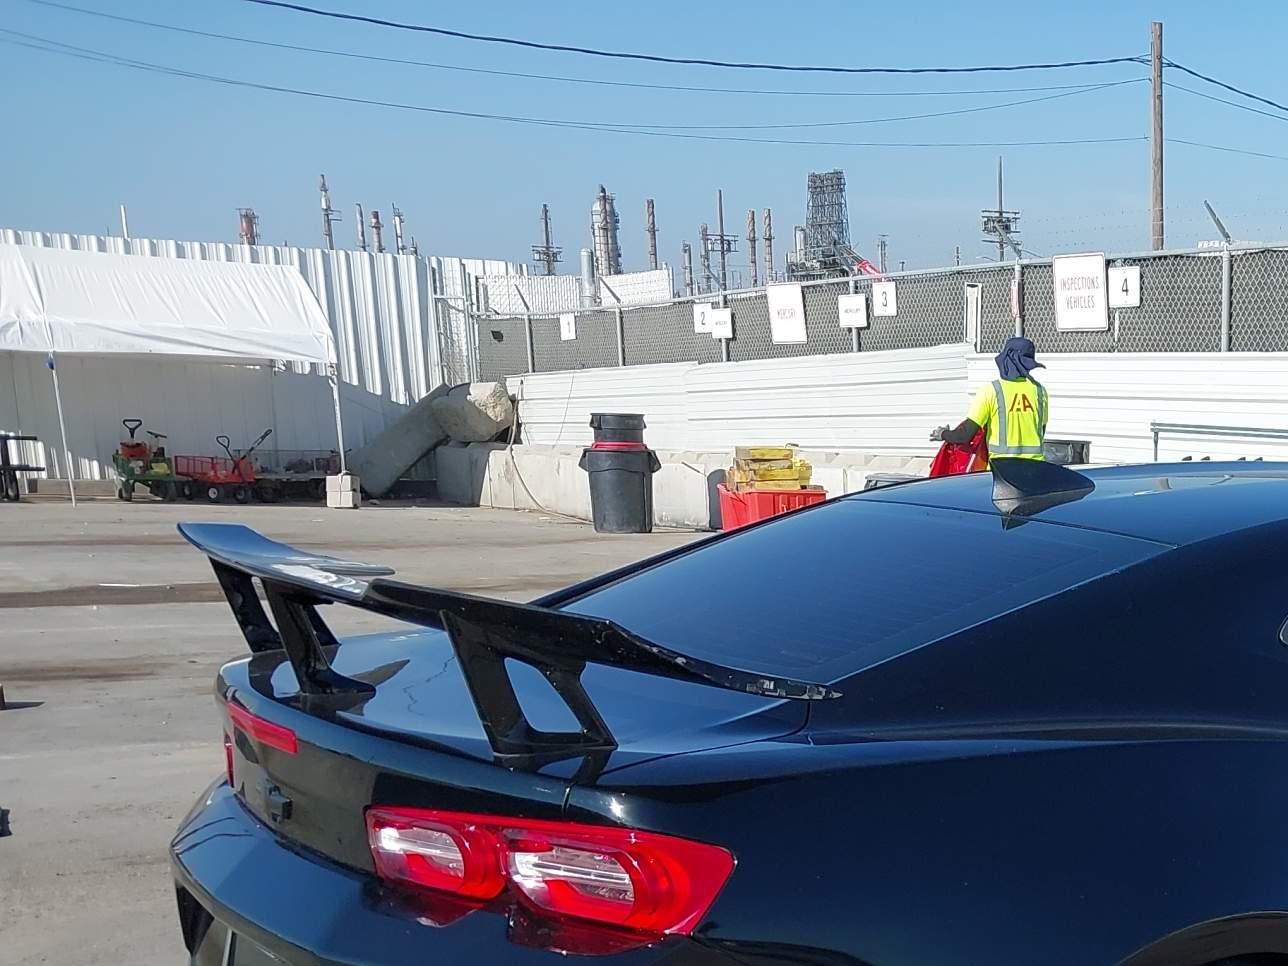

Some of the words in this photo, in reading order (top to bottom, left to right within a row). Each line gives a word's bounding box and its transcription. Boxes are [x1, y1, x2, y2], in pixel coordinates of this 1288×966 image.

[1060, 276, 1100, 290] INSPECTIONS
[1121, 278, 1129, 297] 4
[882, 291, 888, 308] 3
[1066, 295, 1096, 310] VEHICLES
[700, 311, 706, 326] 2
